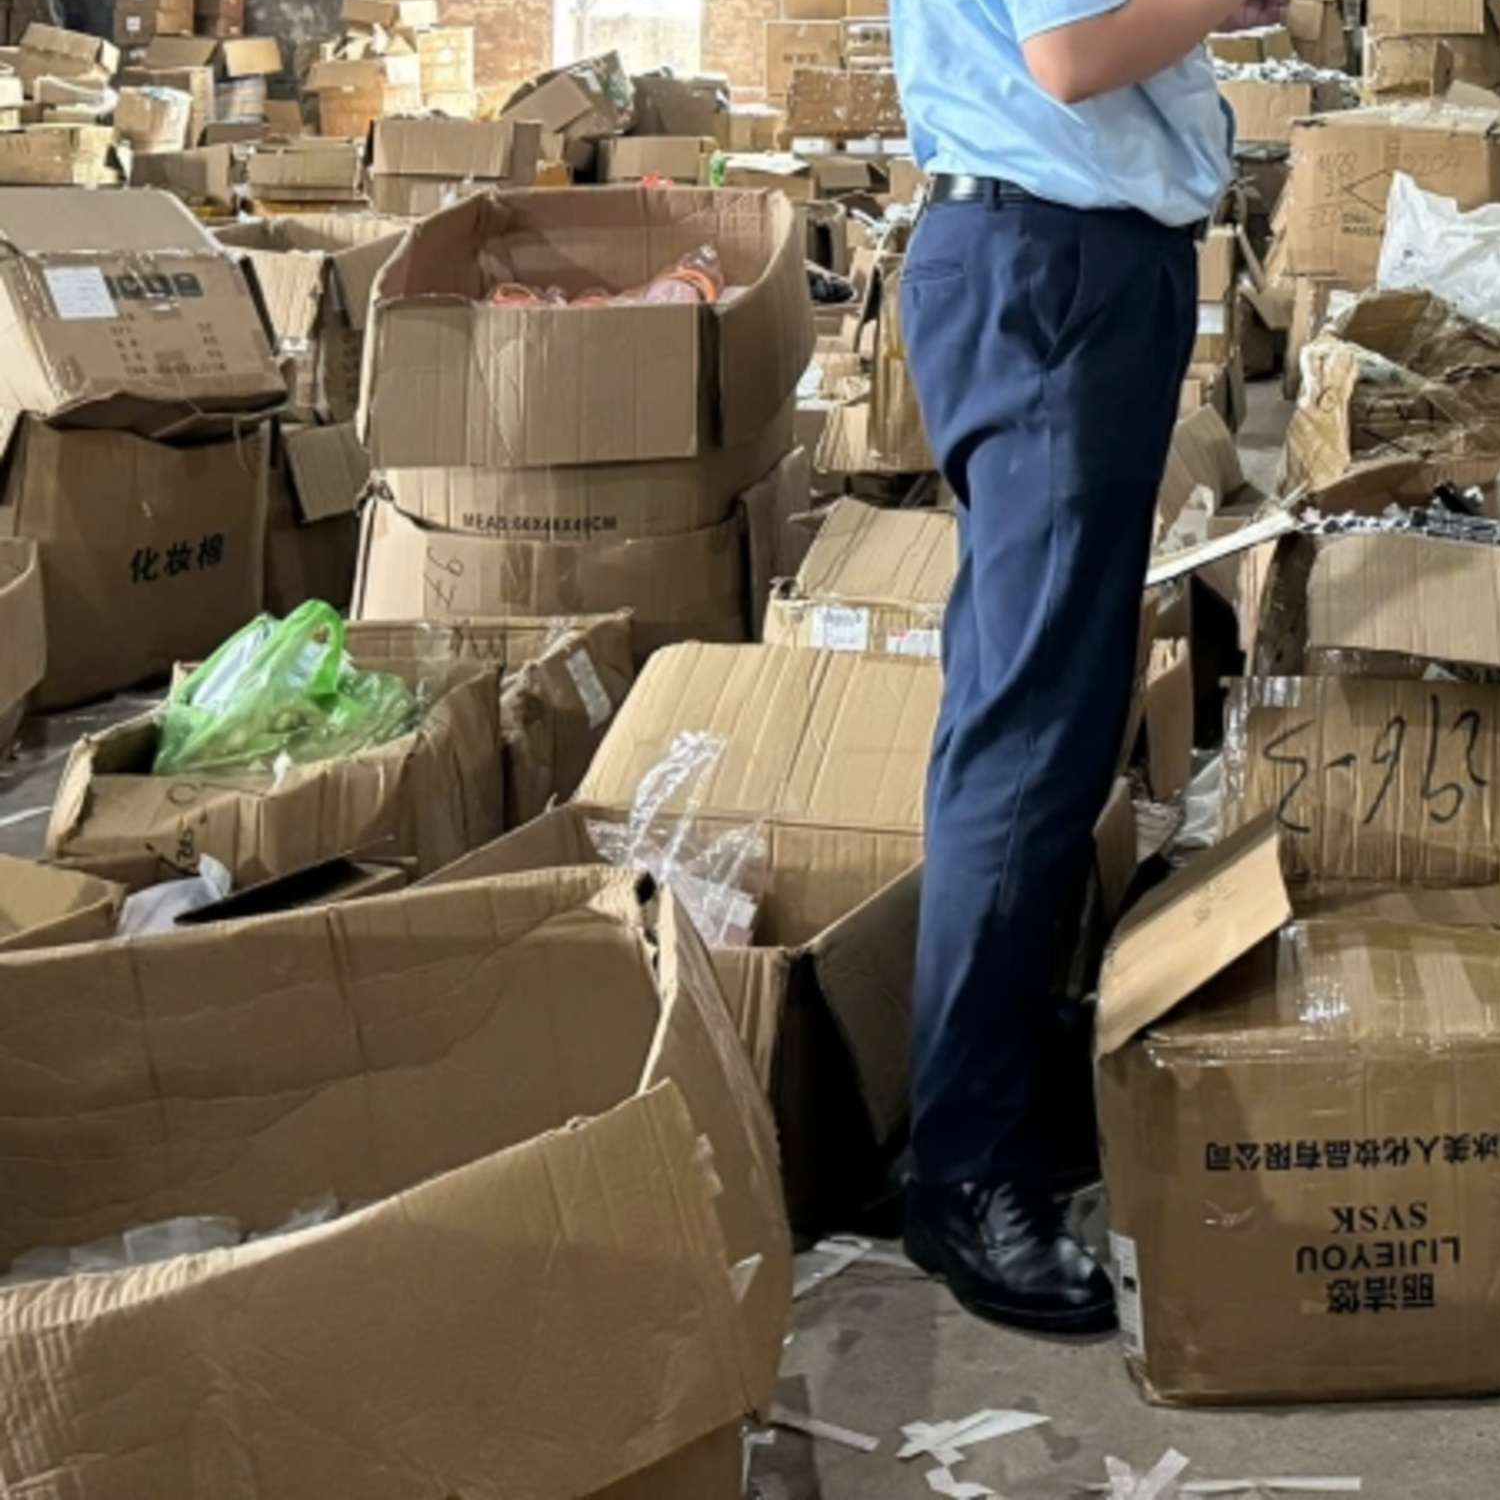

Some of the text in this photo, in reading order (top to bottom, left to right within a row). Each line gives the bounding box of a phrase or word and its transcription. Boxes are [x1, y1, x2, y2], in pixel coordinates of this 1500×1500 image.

[1330, 1202, 1428, 1234] SVSK
[1296, 1236, 1461, 1273] LIJIEYOU
[1327, 1273, 1437, 1314] 丽洁悠
